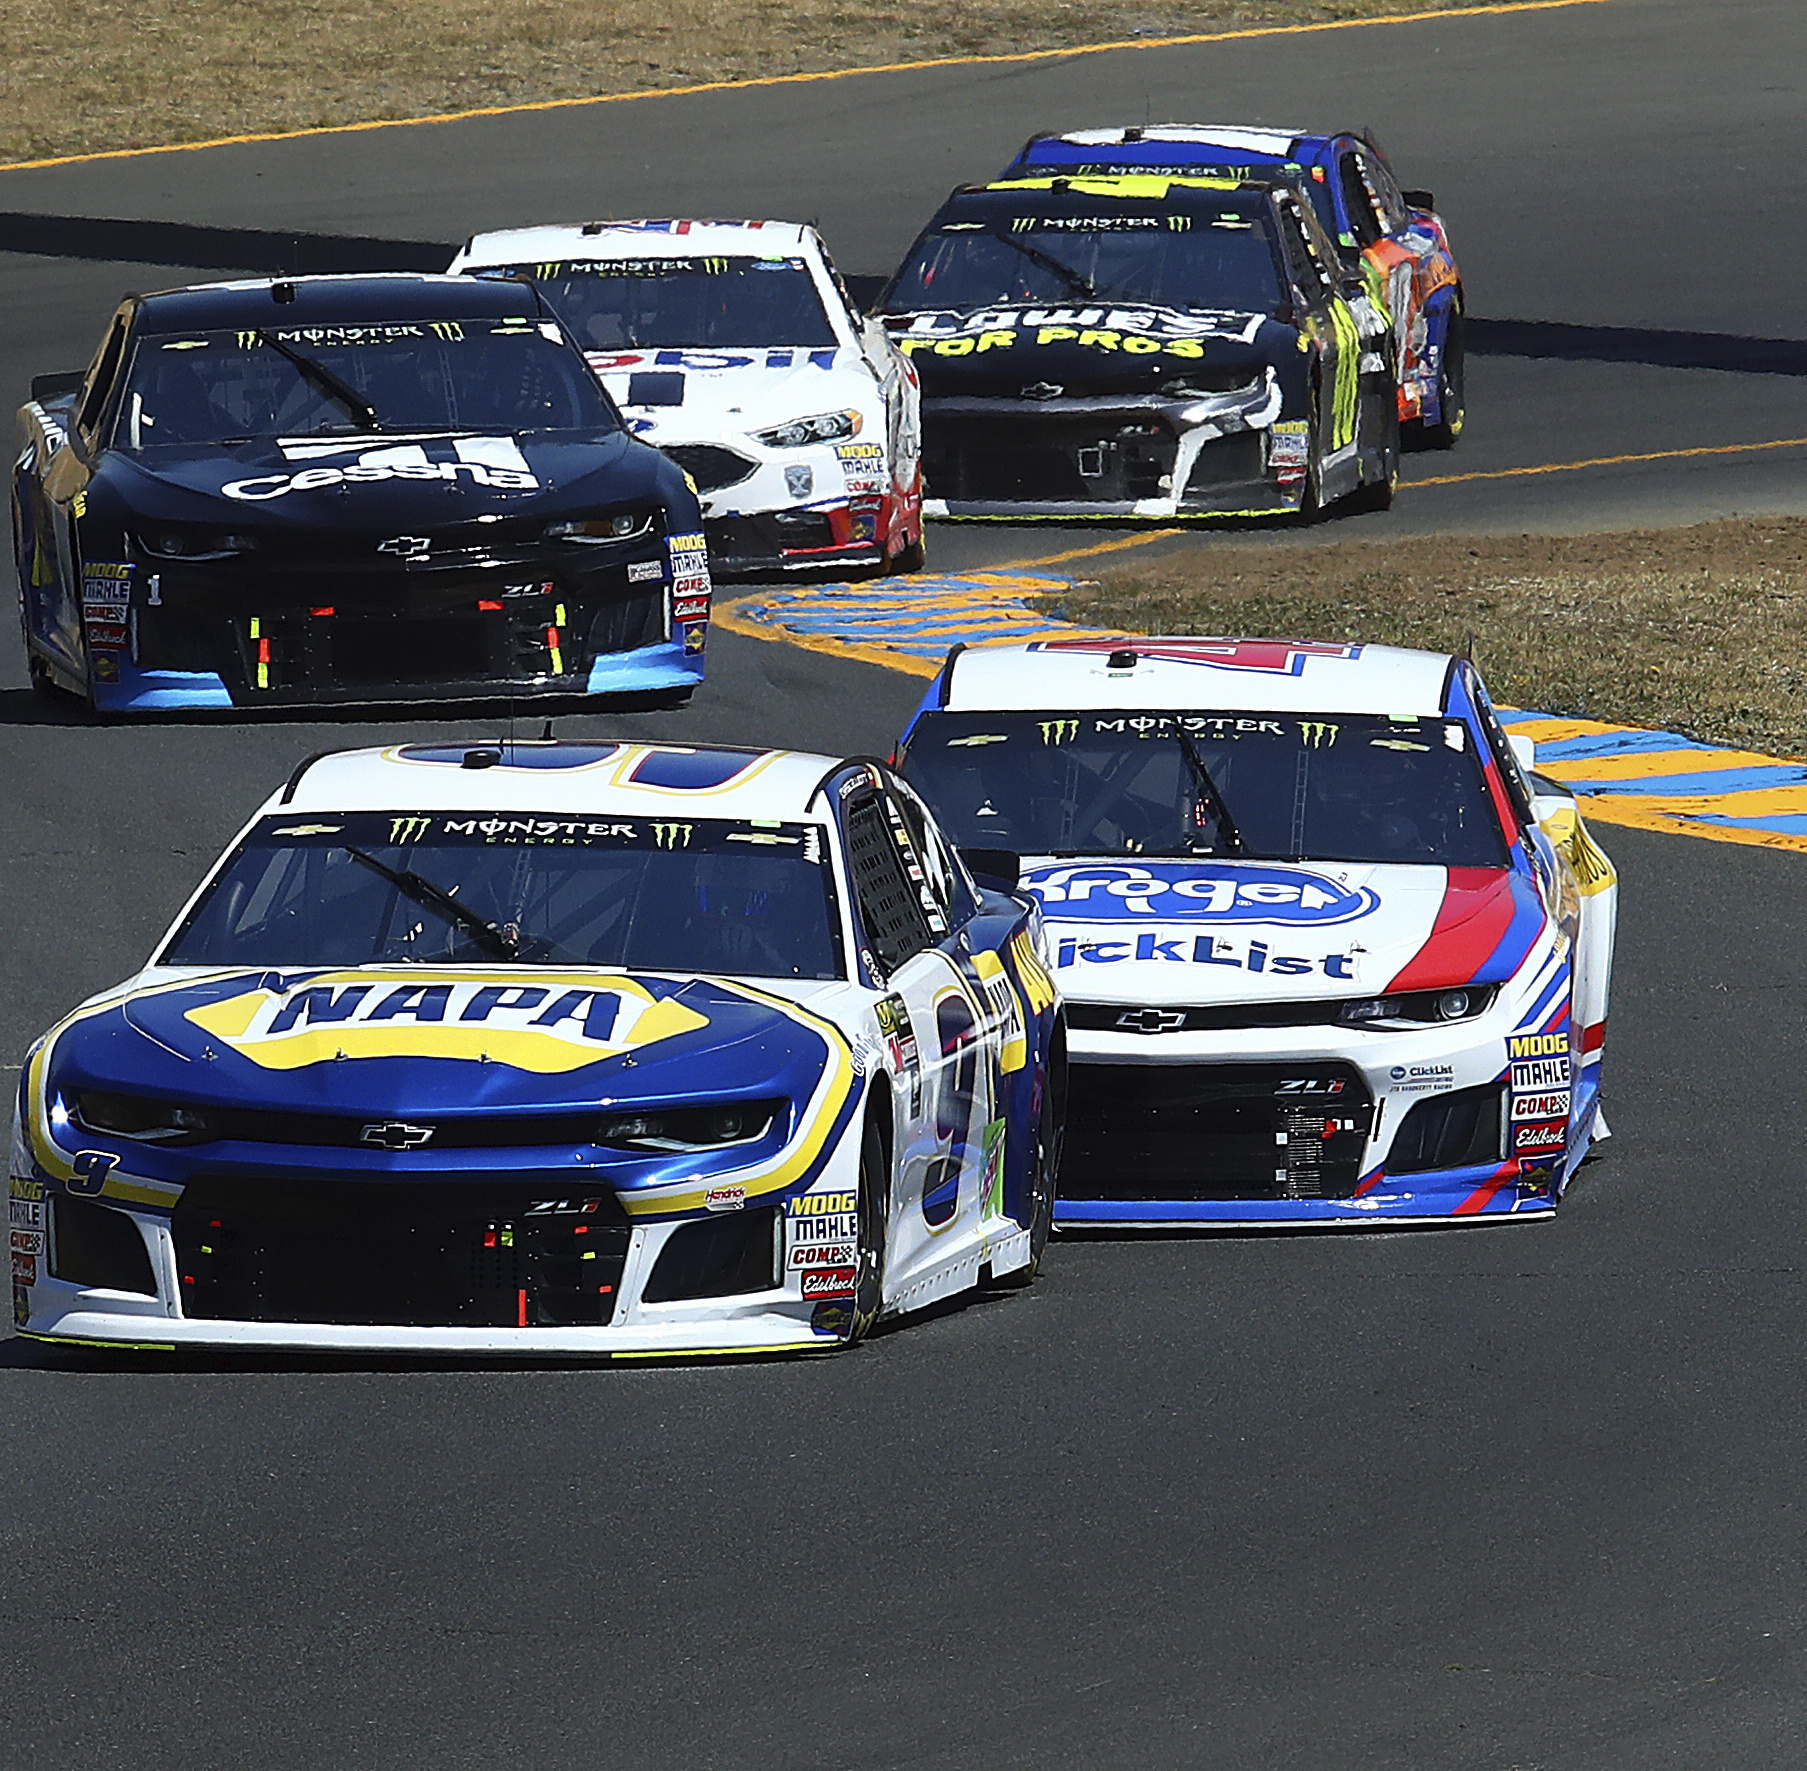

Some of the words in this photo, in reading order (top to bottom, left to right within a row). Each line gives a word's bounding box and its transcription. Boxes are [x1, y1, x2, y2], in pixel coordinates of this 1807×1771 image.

[900, 328, 1017, 358] FOR
[1035, 327, 1205, 359] PROS
[221, 462, 540, 500] Cessna
[1095, 717, 1285, 735] MONSTER
[443, 819, 638, 838] MONSTER
[1057, 932, 1354, 979] ickList
[268, 984, 622, 1042] NAPA
[1510, 1033, 1569, 1058] MOOG
[1513, 1060, 1570, 1086] MAHLE
[1515, 1094, 1558, 1116] COMP
[66, 1149, 122, 1197] 9
[705, 1188, 746, 1201] Hendrick
[790, 1192, 856, 1216] MOOG
[795, 1216, 857, 1241] MAHLE
[793, 1247, 840, 1265] COMP
